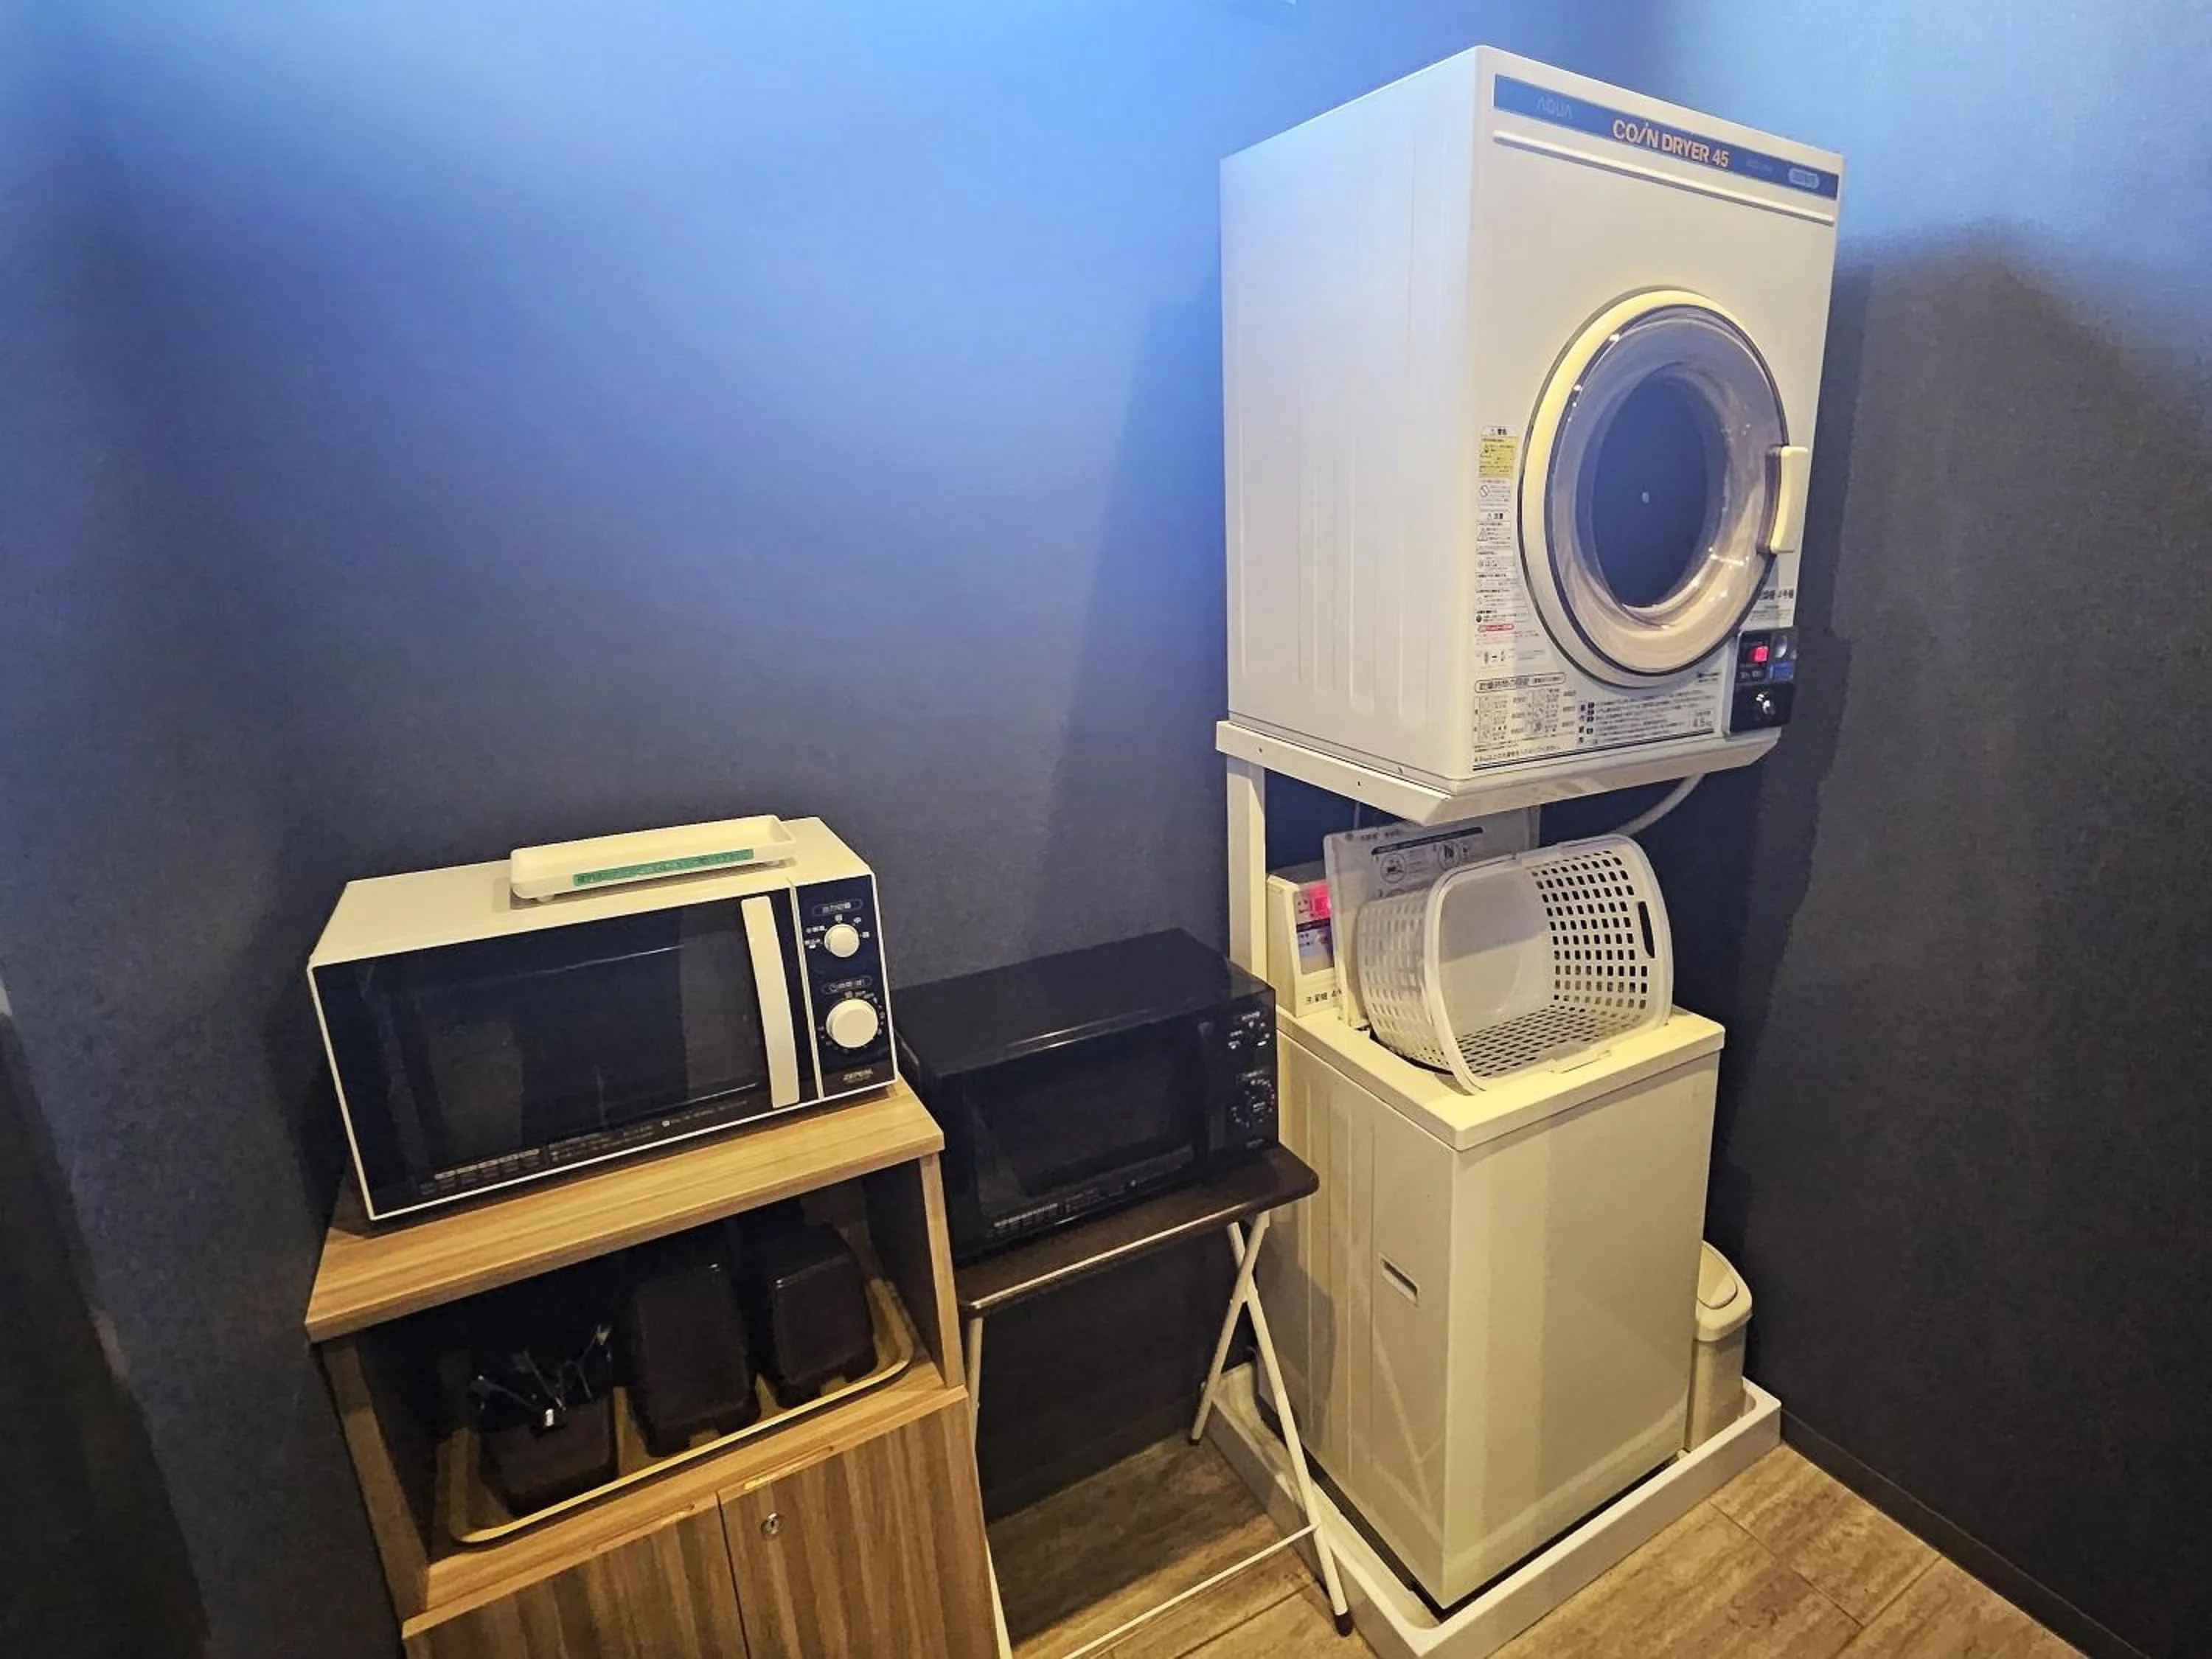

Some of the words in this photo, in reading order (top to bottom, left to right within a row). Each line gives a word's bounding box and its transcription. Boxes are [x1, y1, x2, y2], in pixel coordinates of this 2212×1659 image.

[1537, 95, 1573, 119] AQUA
[1661, 133, 1710, 164] DRYER
[1712, 149, 1730, 168] 45
